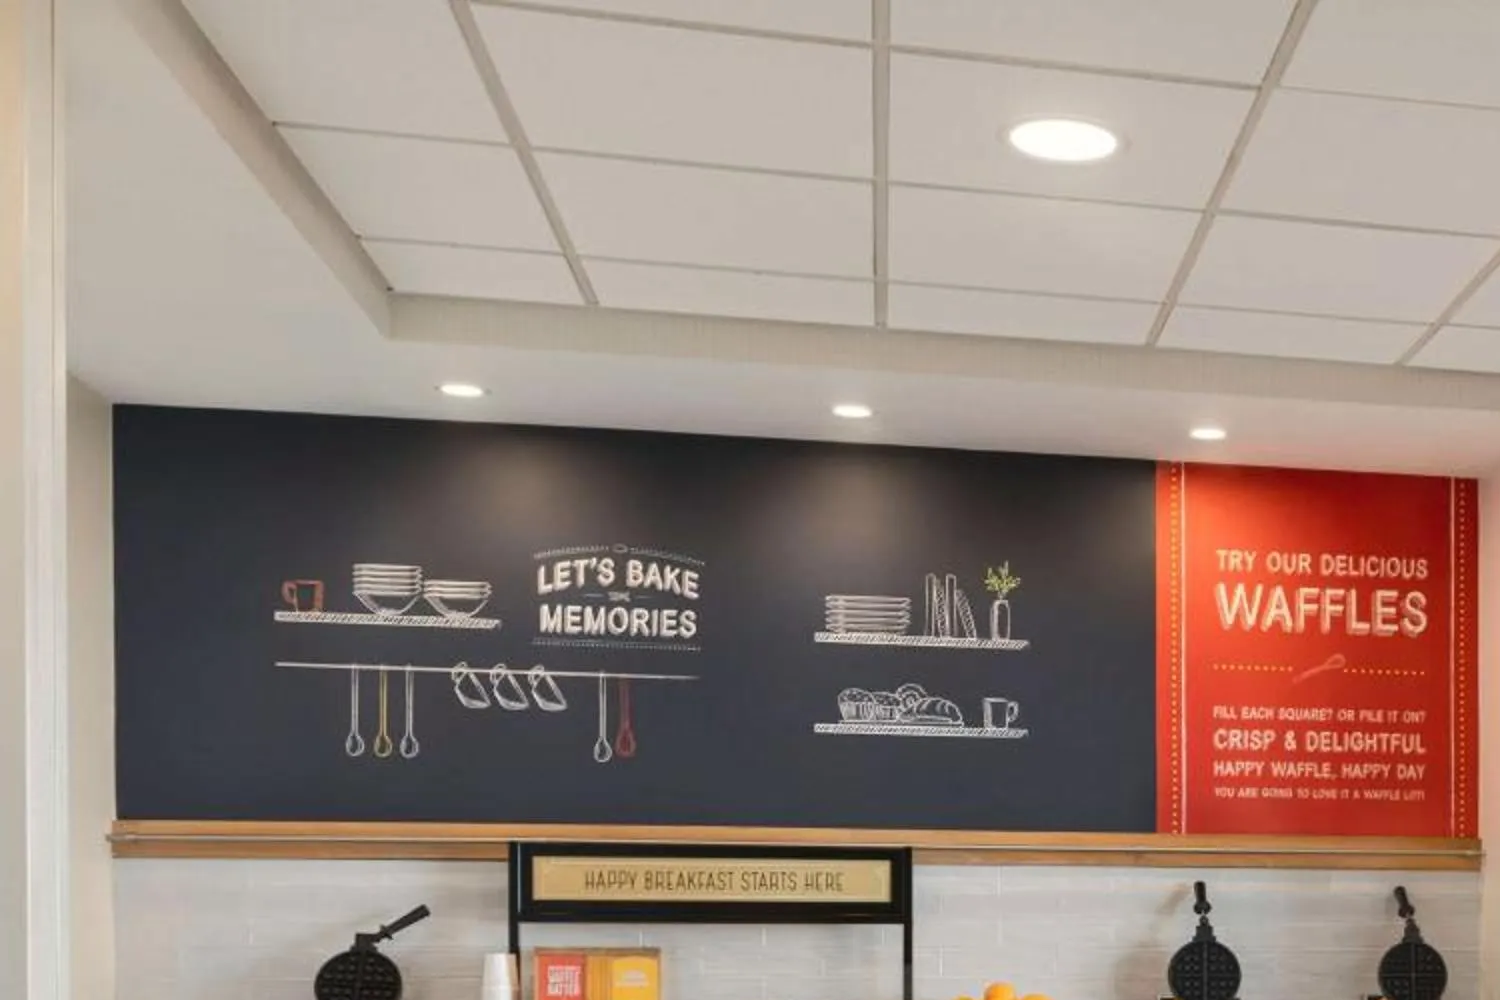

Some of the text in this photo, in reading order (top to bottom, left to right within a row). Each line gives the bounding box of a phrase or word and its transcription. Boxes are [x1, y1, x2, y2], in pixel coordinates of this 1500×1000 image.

[1216, 549, 1429, 580] TRY OUR DELICIOUS
[537, 557, 700, 600] LET'S BAKE
[539, 603, 698, 639] MEMORIES
[1214, 582, 1429, 638] WAFFLES
[1213, 705, 1238, 720] FILL
[1241, 706, 1275, 721] EACH
[1278, 707, 1334, 722] SQUARE?
[1337, 708, 1356, 722] OR
[1359, 709, 1384, 723] PILE
[1387, 710, 1399, 724] IT
[1213, 727, 1427, 754] CRISP & DELIGHTFUL
[1213, 760, 1426, 780] HAPPY WAFFLE, HAPPY DAY
[1215, 787, 1235, 798] YOU
[1237, 787, 1259, 798] ARE
[1297, 788, 1310, 799] TO
[585, 869, 845, 892] HAPPY BREAKFAST STARTS HERE
